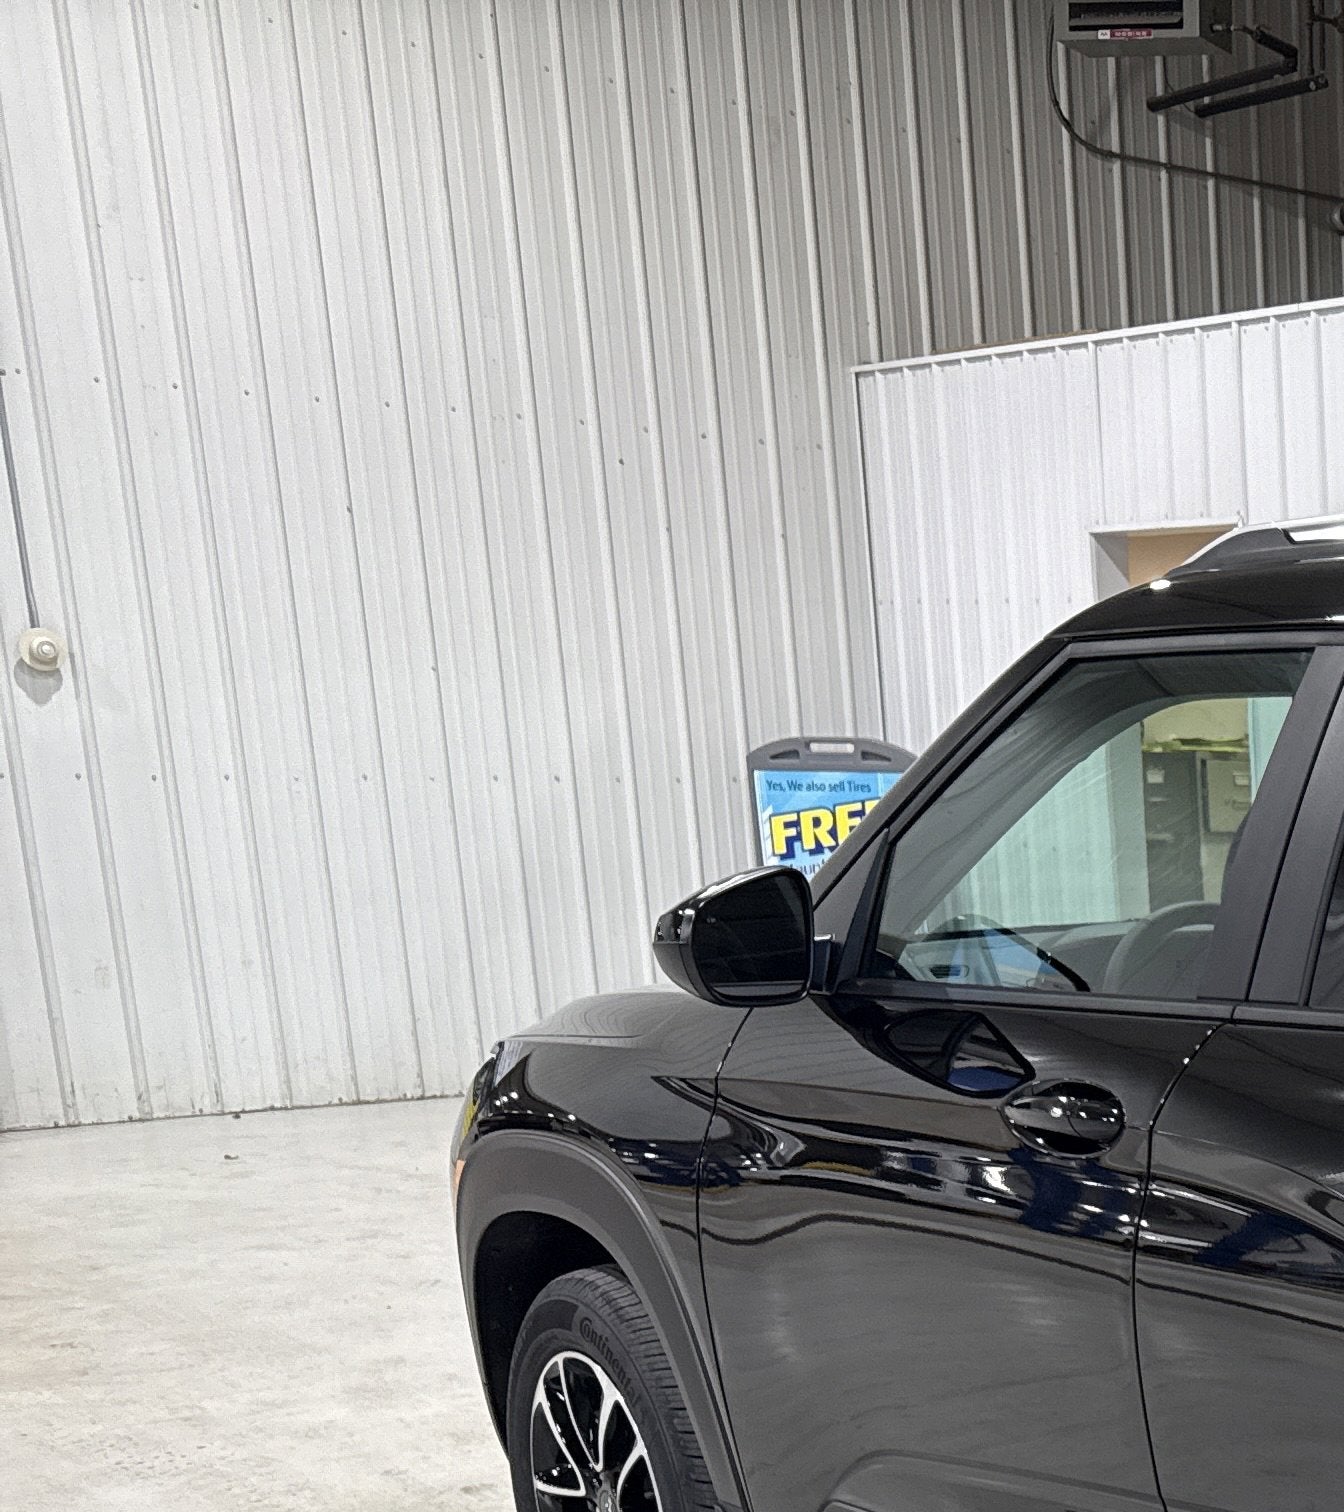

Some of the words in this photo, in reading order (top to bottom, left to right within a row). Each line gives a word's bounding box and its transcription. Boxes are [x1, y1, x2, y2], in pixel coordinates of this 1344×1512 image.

[766, 780, 785, 793] Yes,
[787, 780, 803, 791] We
[806, 782, 826, 792] also
[829, 781, 845, 792] sell
[847, 780, 871, 793] Tires
[770, 797, 882, 855] FRE
